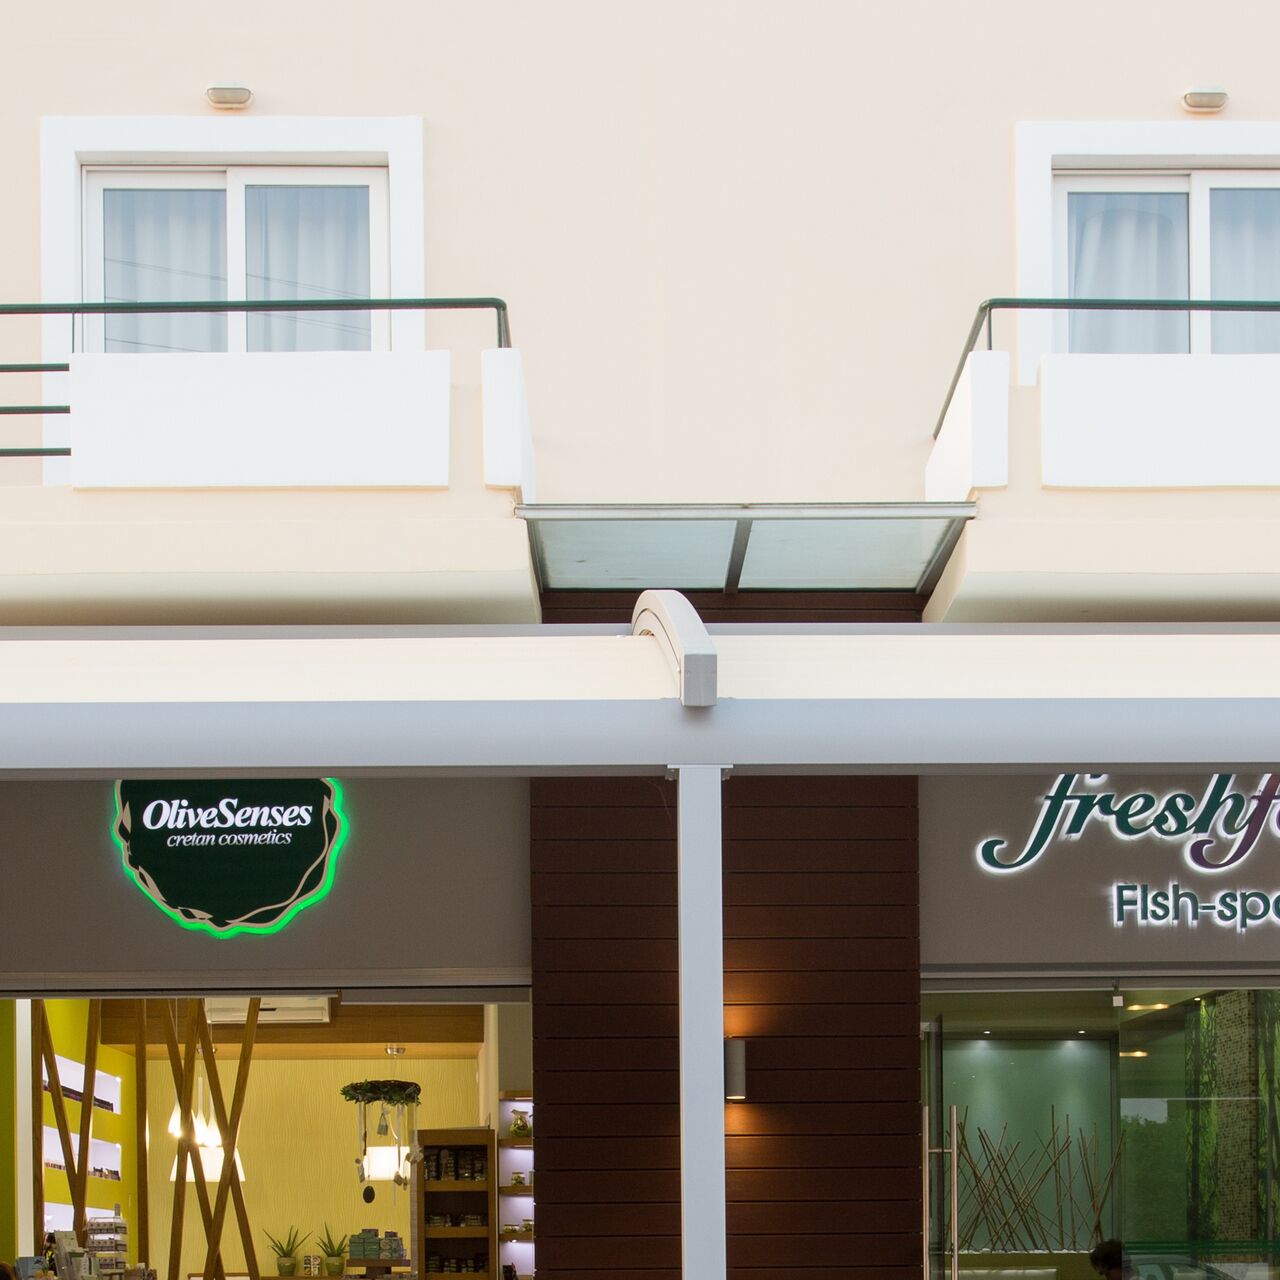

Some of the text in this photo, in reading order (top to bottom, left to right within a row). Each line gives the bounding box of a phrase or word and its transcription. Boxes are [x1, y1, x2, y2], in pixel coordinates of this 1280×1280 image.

[142, 798, 313, 830] OliveSenses
[166, 829, 293, 847] cretan cosmetics
